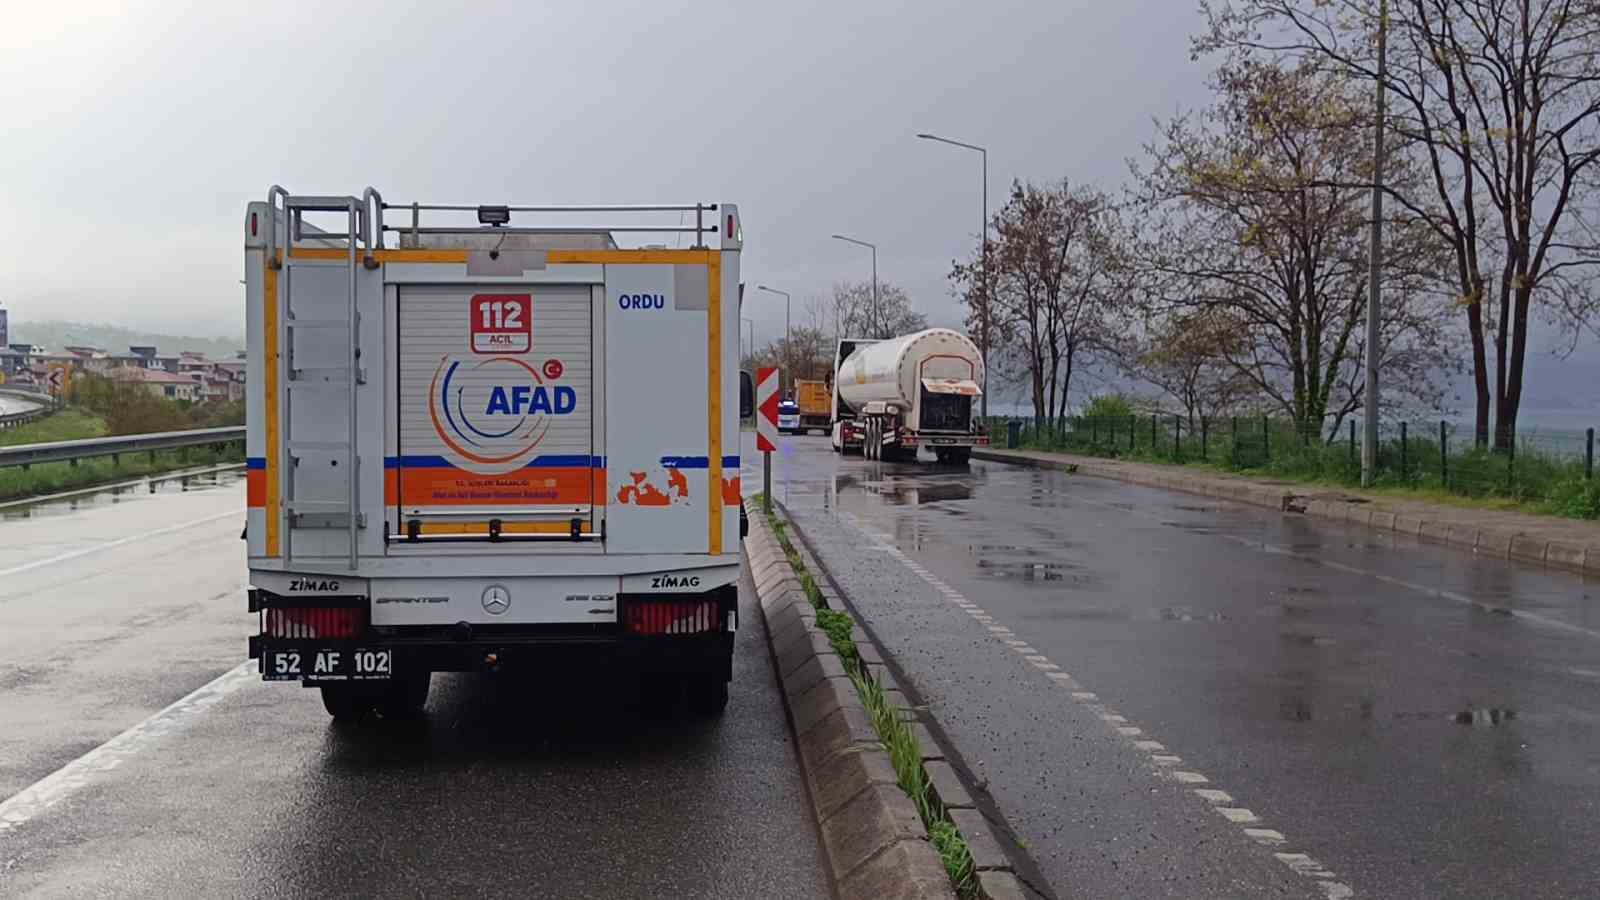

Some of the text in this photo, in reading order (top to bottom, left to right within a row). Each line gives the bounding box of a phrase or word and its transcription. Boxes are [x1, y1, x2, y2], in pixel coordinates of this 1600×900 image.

[479, 300, 523, 328] 112
[618, 293, 665, 310] ORDU
[485, 385, 577, 415] AFAD
[275, 651, 389, 673] 52 AF 102
